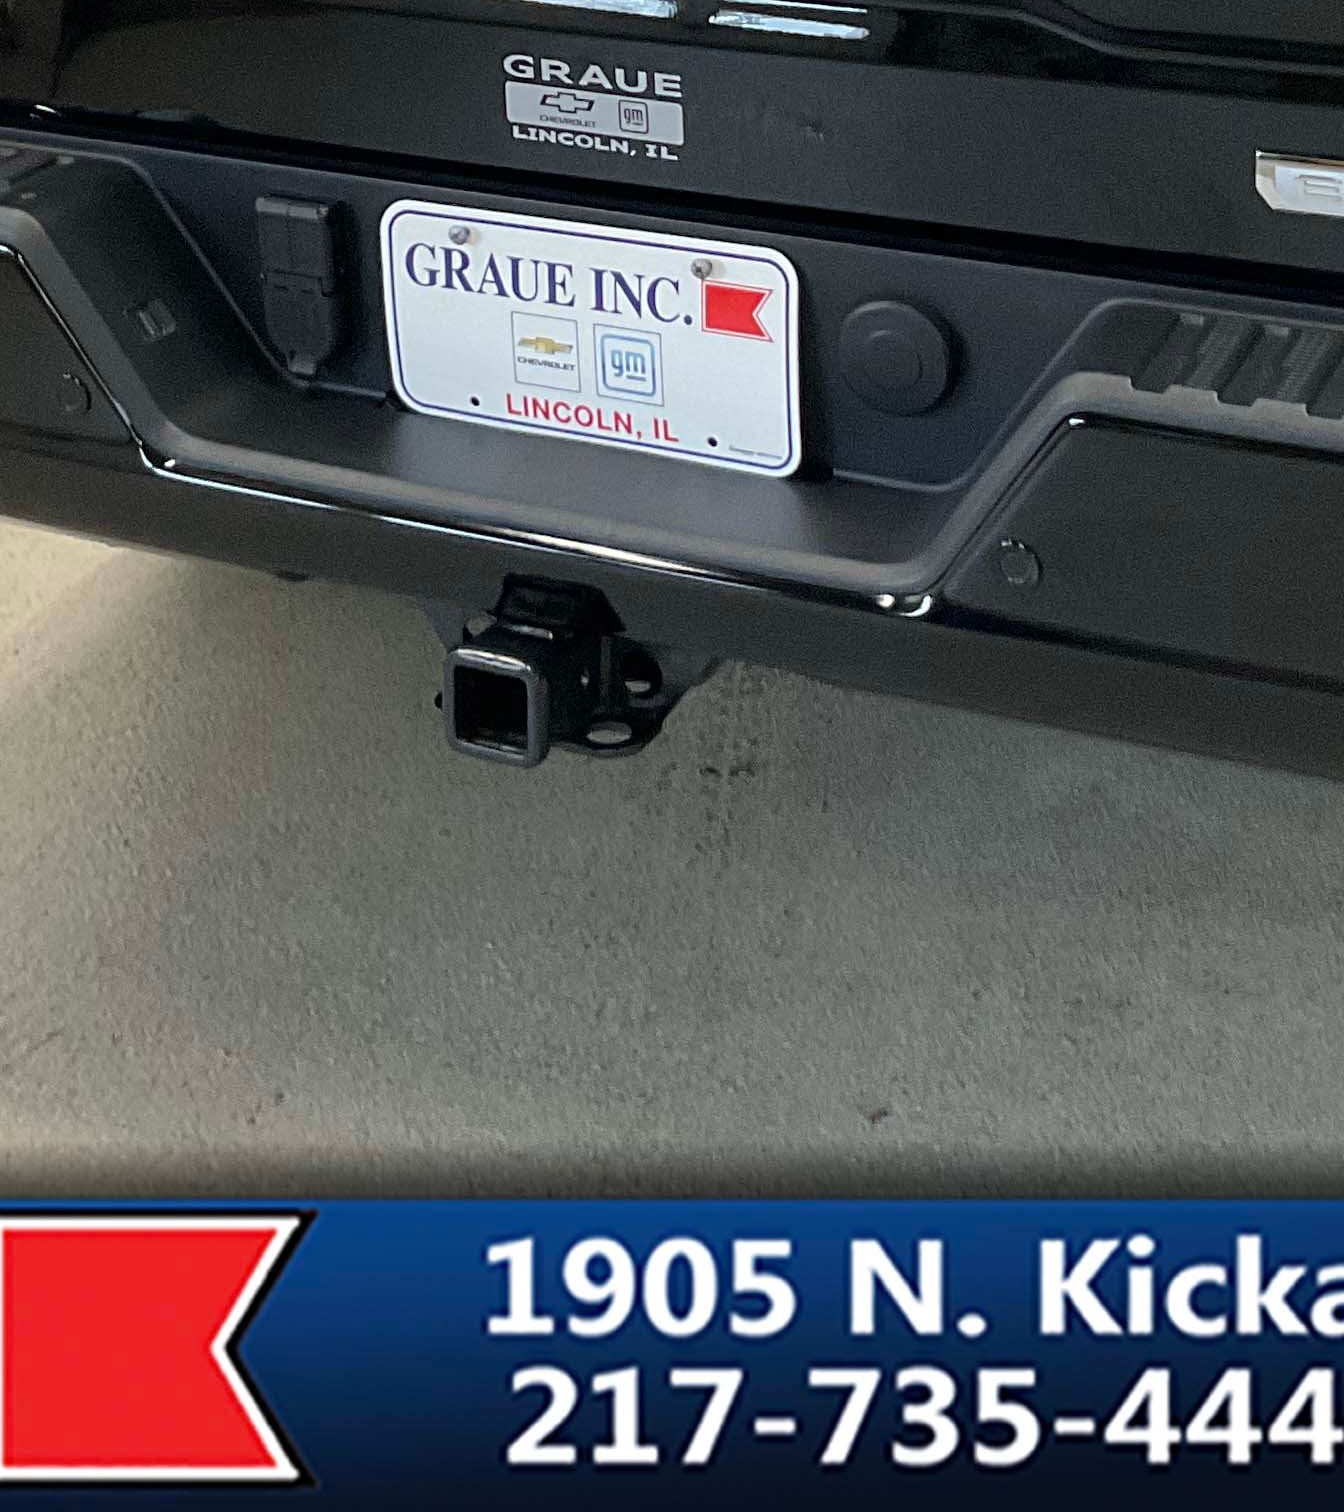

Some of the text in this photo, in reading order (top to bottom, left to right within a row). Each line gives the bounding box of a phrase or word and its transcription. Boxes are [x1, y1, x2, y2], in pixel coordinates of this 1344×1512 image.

[503, 54, 682, 98] GRAUE
[623, 107, 644, 125] gm
[512, 125, 679, 161] LINCOLN, IL
[405, 242, 693, 326] GRAUE INC.
[516, 355, 578, 372] CHEVROLET
[610, 347, 647, 378] gm
[506, 393, 680, 443] LINCOLN, IL
